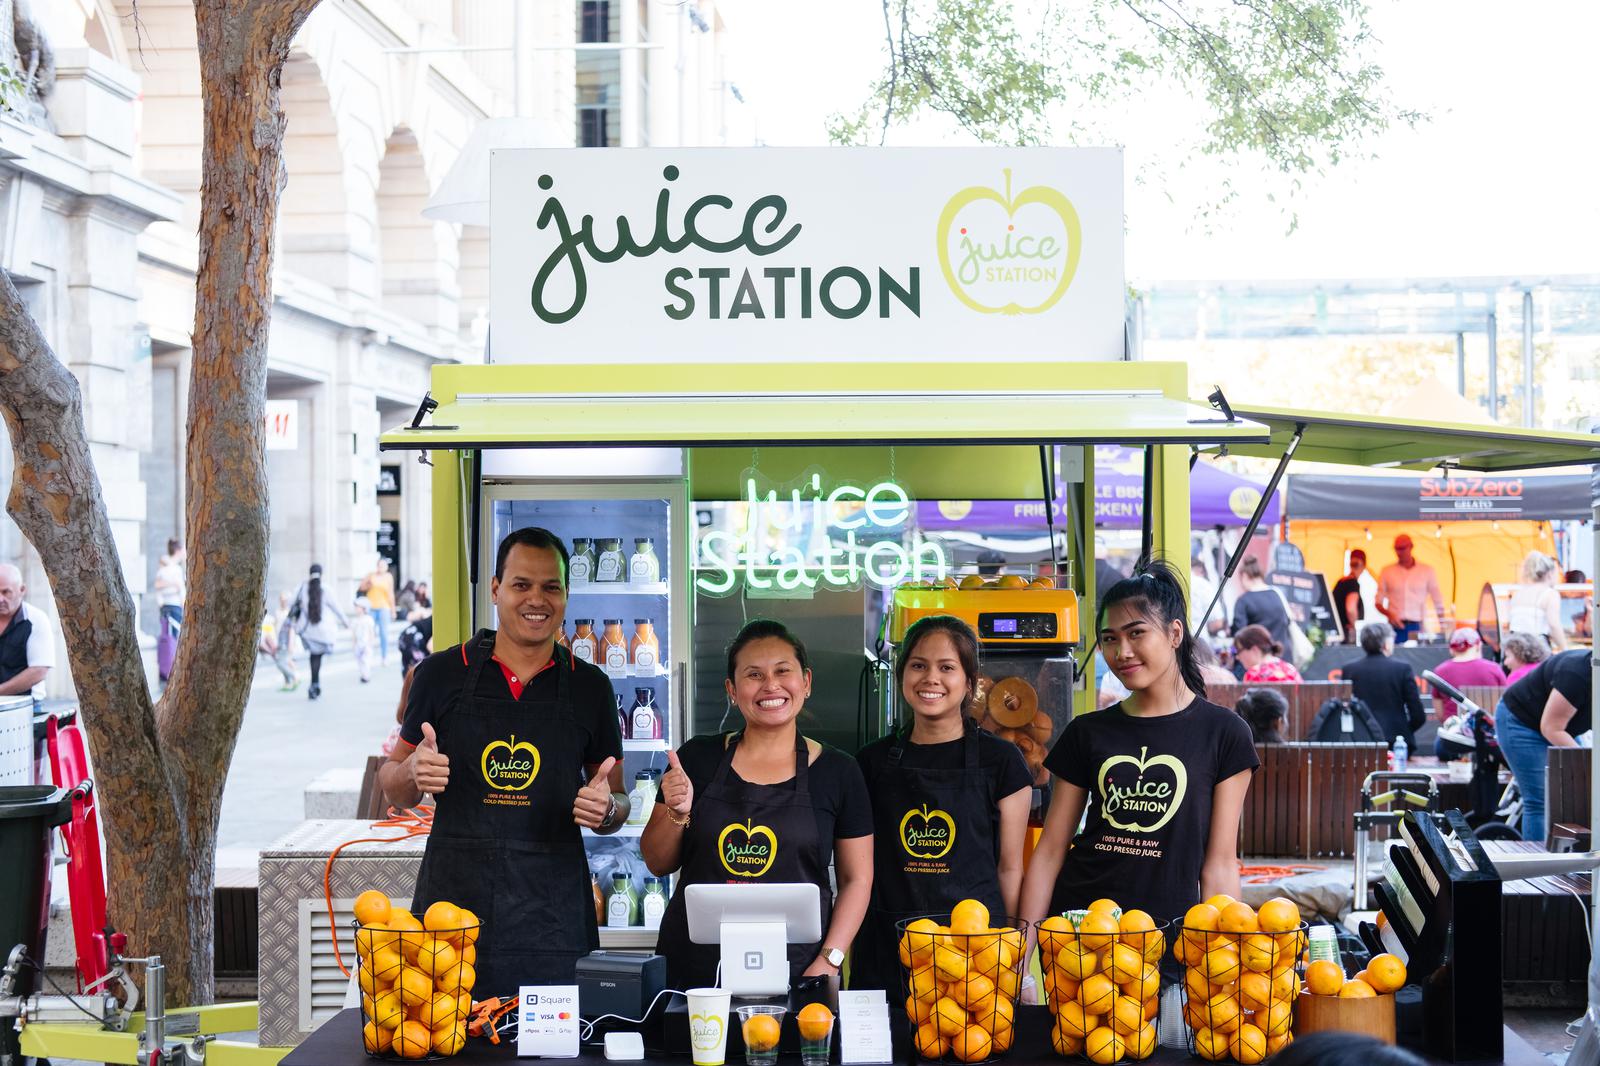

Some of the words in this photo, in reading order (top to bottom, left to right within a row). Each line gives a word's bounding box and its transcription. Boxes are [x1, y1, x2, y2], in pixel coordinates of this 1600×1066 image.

[531, 164, 802, 324] juice
[959, 224, 1060, 285] juice
[985, 266, 1057, 282] STATION
[664, 265, 922, 321] STATION
[1420, 478, 1523, 497] SubZero
[738, 473, 909, 542] Juice
[1014, 502, 1060, 518] FRIED
[1062, 501, 1133, 517] CCKEN
[697, 530, 946, 593] Station
[488, 755, 532, 779] juice
[500, 771, 529, 779] STATION
[1106, 775, 1172, 814] juice
[1122, 800, 1168, 813] STATION
[908, 824, 947, 846] juice
[1102, 835, 1116, 844] 100%
[1116, 836, 1135, 846] PURE
[1135, 839, 1141, 847] &
[1141, 840, 1160, 848] RAW
[725, 838, 769, 863] juice
[736, 856, 767, 864] STATION
[1094, 843, 1113, 852] COLD
[1113, 845, 1142, 856] PRESSED
[1141, 848, 1163, 858] JUICE
[540, 995, 572, 1005] Square
